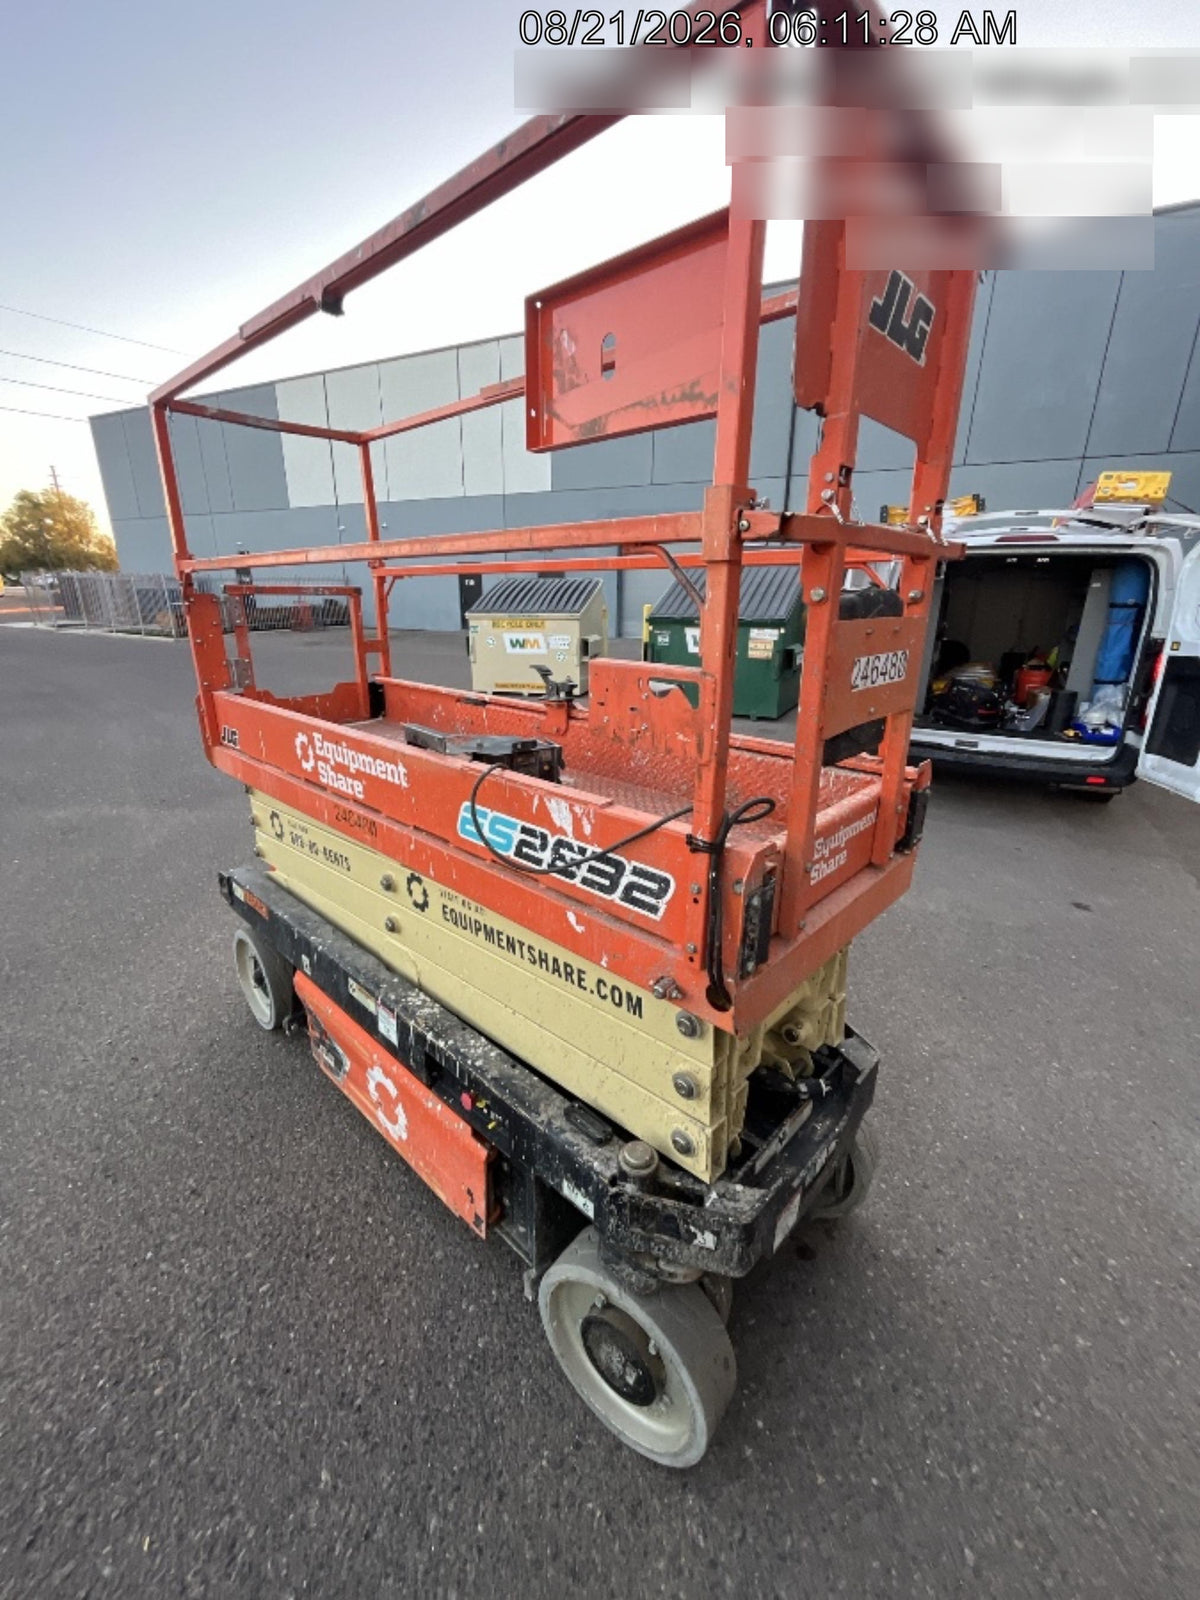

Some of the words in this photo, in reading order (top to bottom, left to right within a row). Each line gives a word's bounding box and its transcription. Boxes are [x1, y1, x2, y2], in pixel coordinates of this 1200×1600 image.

[869, 270, 935, 365] JLG
[509, 637, 540, 649] WM
[312, 731, 409, 788] Equipment
[317, 764, 364, 799] Share
[810, 849, 848, 886] Share
[442, 903, 644, 1019] EQUIPMENTSHARE.COM
